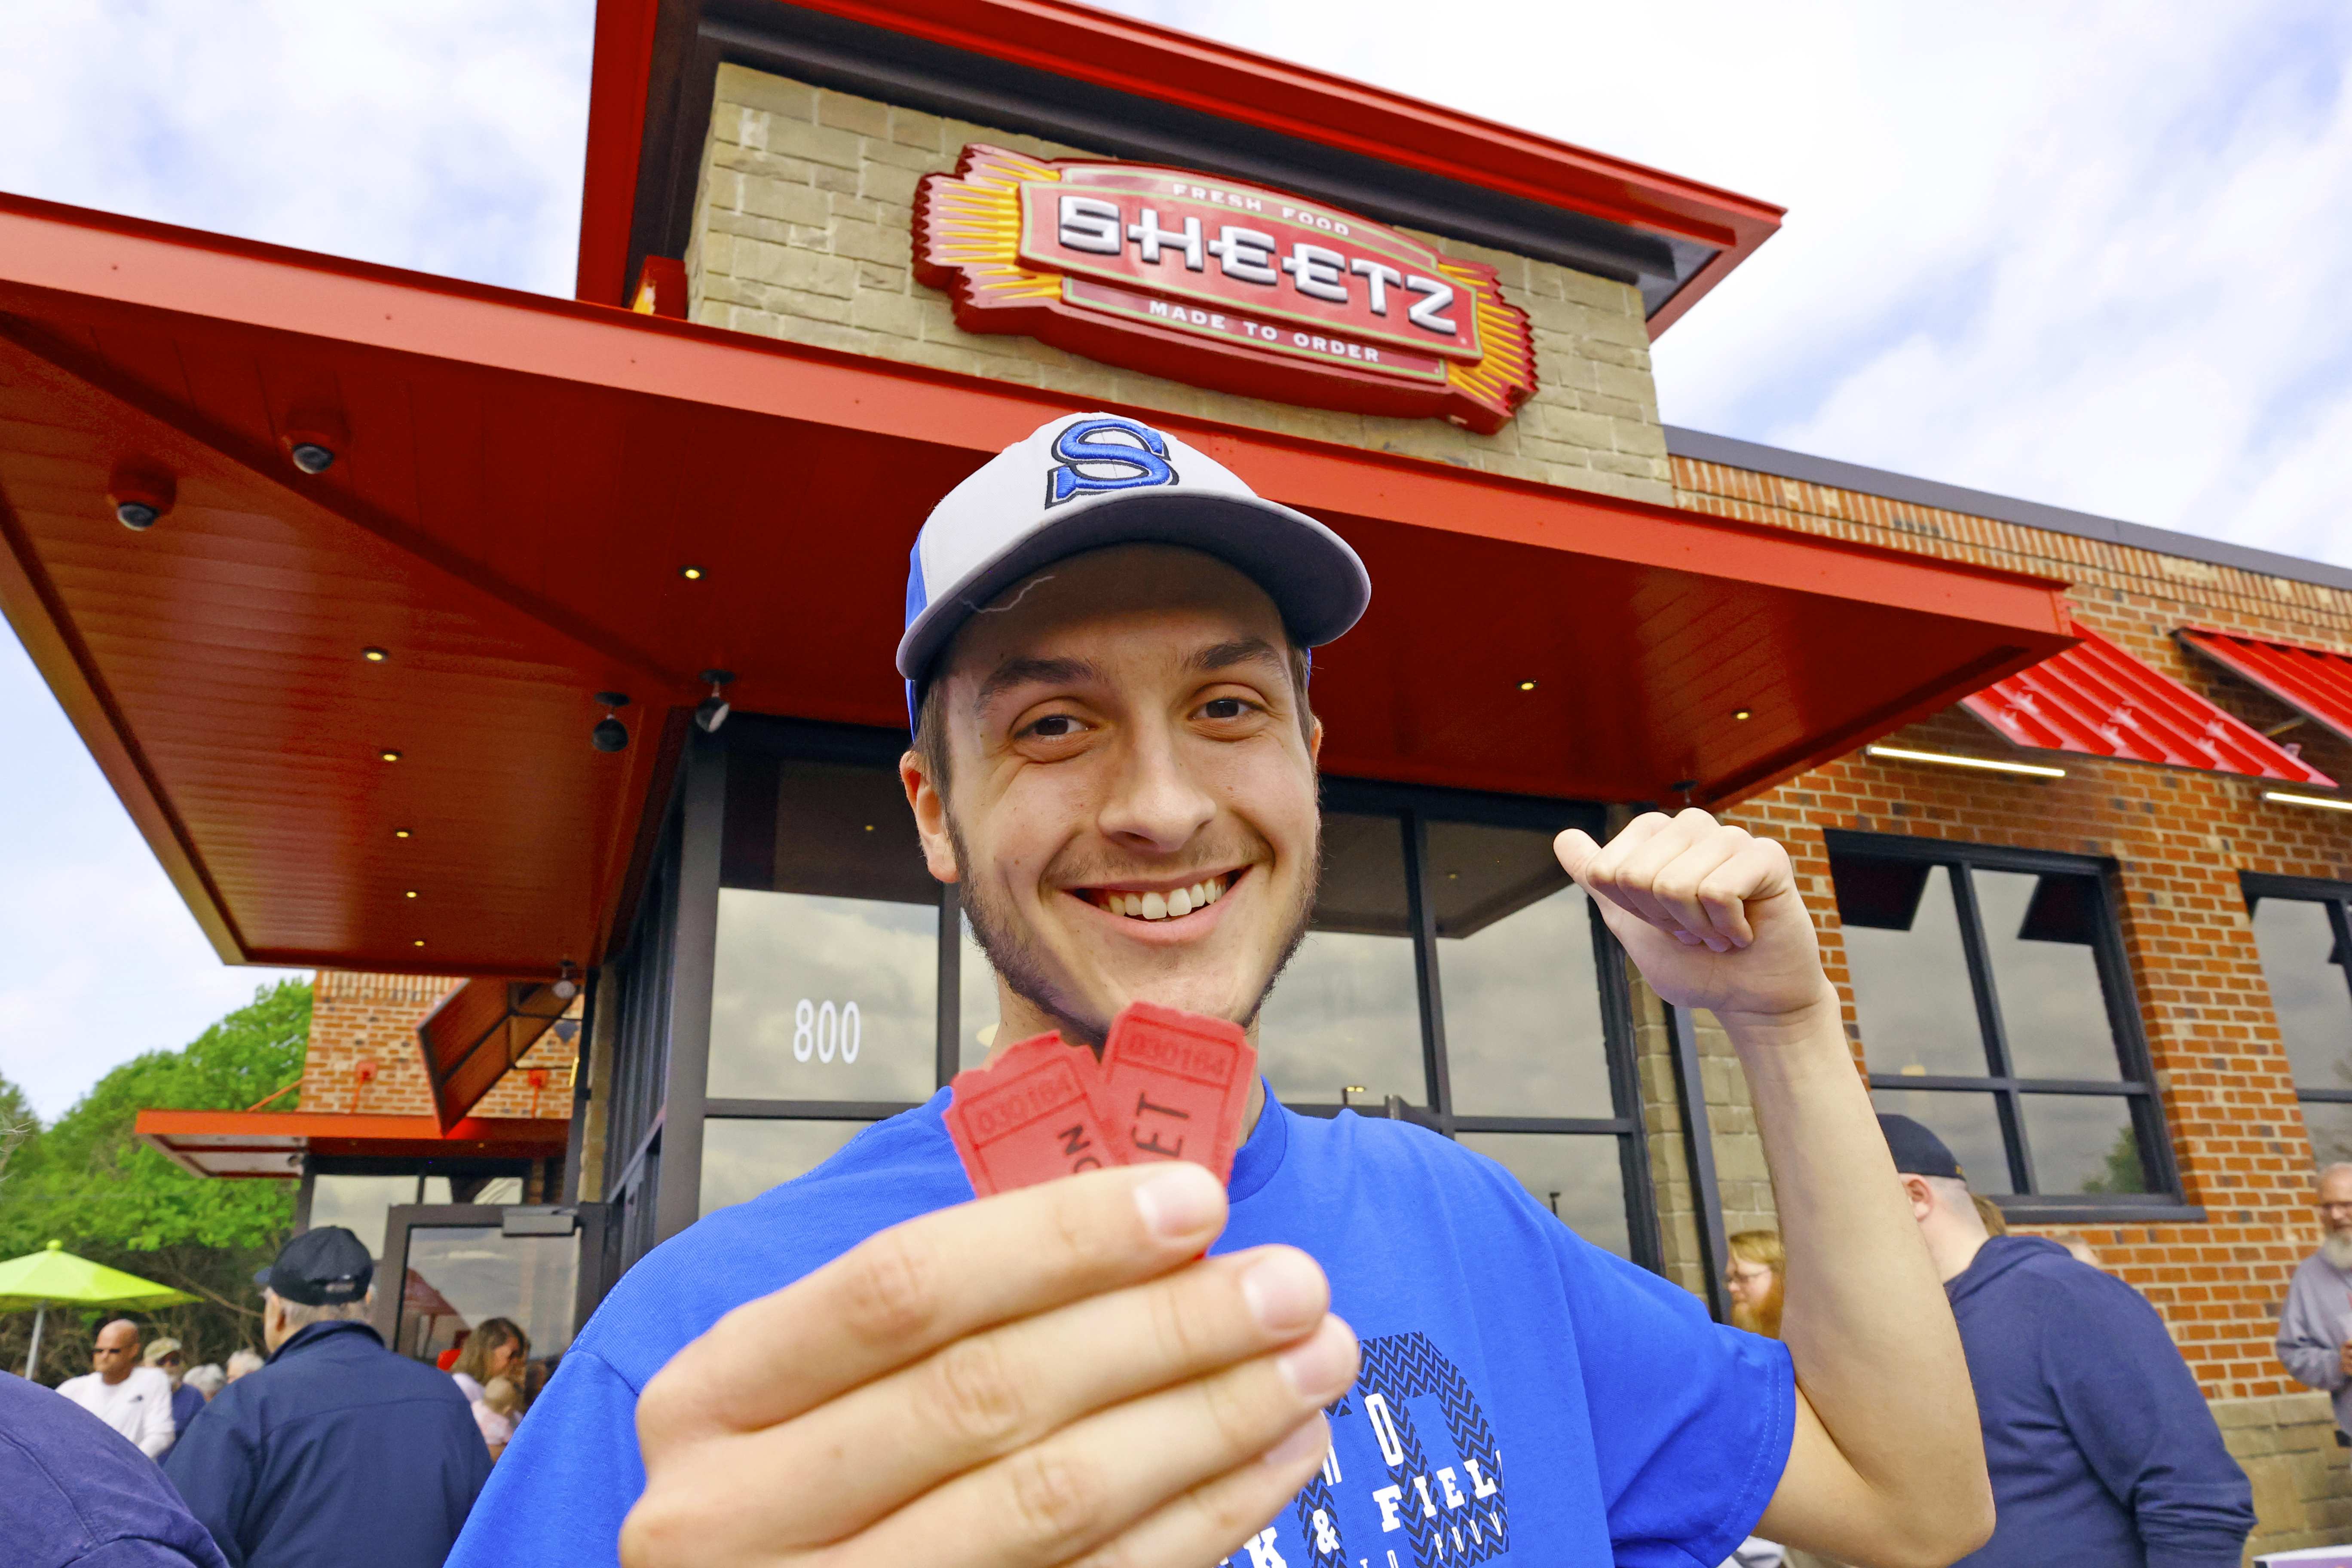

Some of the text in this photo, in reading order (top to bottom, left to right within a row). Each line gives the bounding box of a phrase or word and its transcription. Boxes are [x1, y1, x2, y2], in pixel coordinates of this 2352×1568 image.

[1173, 183, 1349, 236] FRESH FOOD
[1059, 195, 1457, 335] SHEETZ
[1149, 300, 1379, 362] MADE TO ORDER
[1045, 419, 1179, 509] S
[793, 998, 861, 1064] 800
[1312, 1509, 1340, 1554] &
[1372, 1449, 1504, 1533] FIEL
[1433, 1507, 1508, 1560] PROV
